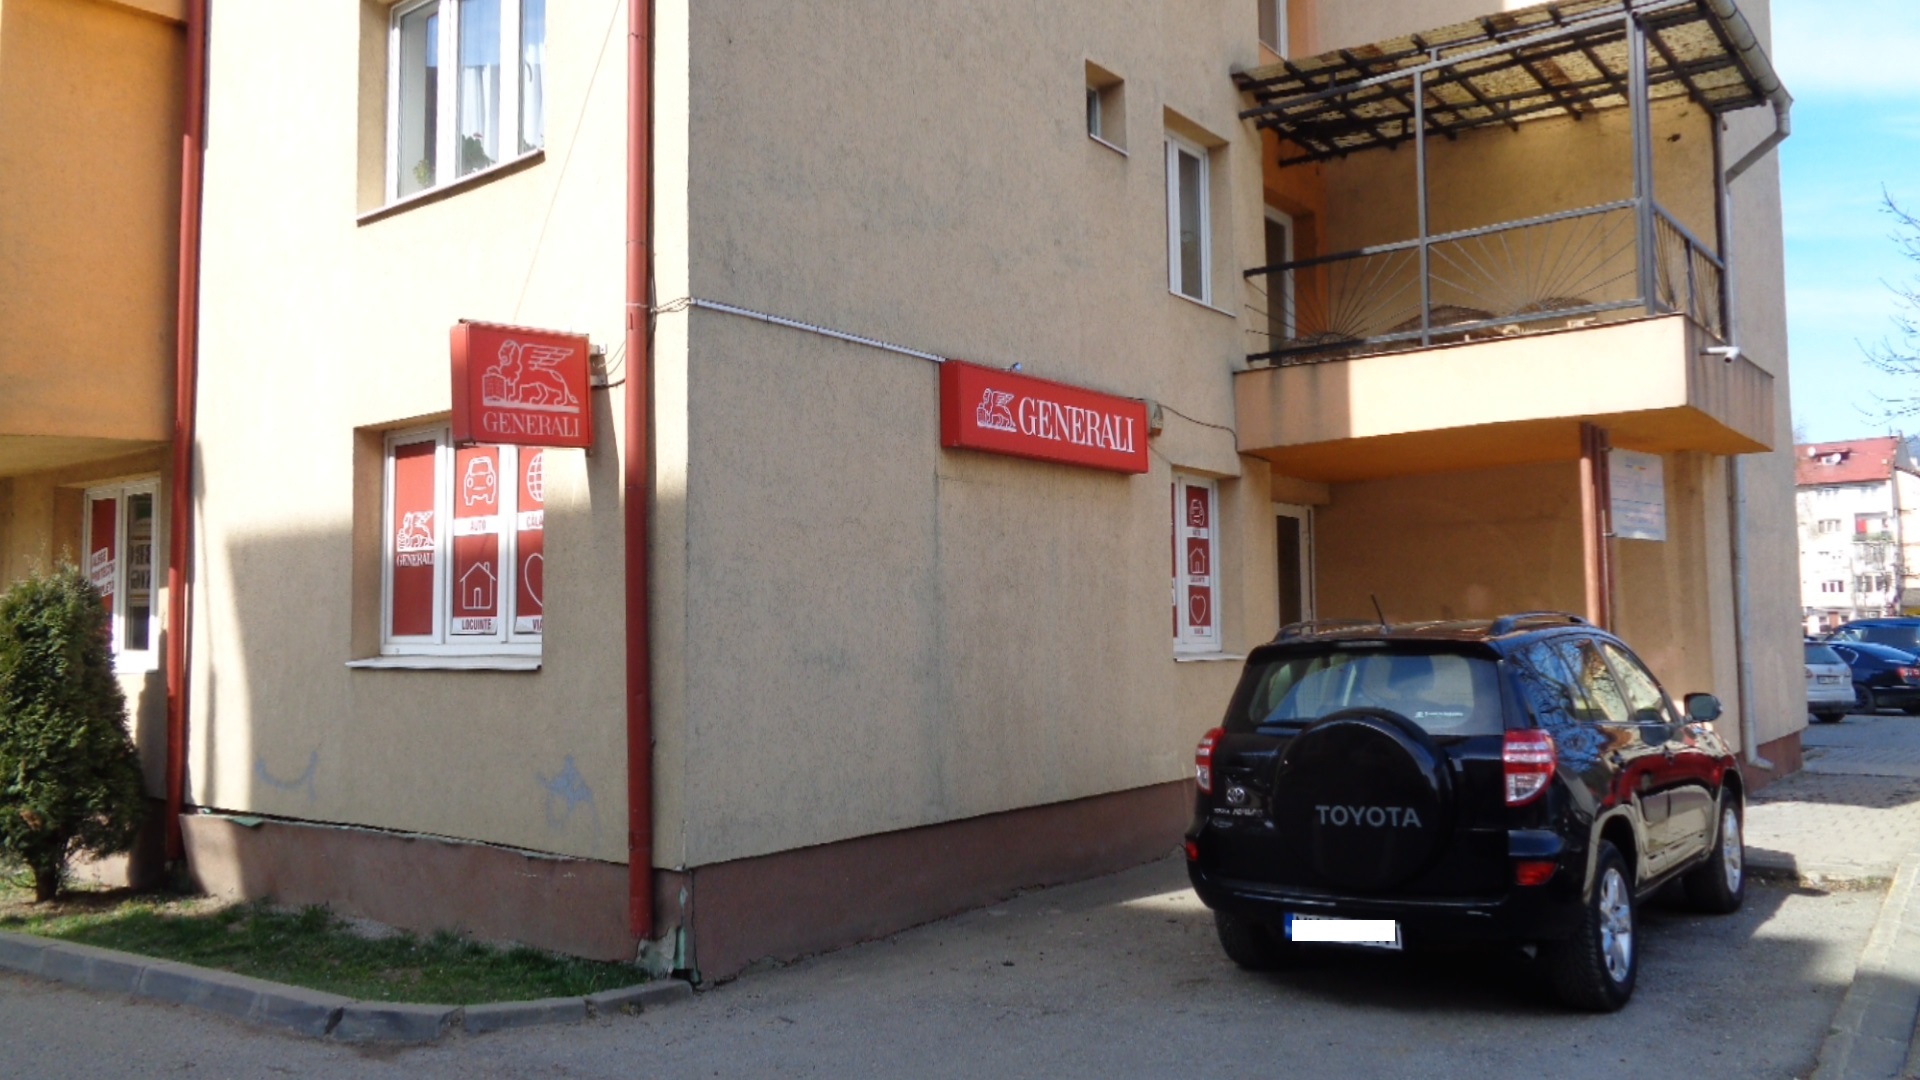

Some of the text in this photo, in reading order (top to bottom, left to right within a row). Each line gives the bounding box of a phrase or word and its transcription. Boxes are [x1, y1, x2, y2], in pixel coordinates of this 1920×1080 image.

[483, 411, 579, 437] GENERALI
[1018, 397, 1135, 453] GENERALI
[470, 519, 487, 531] AUTO
[396, 552, 434, 567] GENERALI
[461, 617, 492, 631] LOCUINTE
[1315, 804, 1422, 828] TOYOTA
